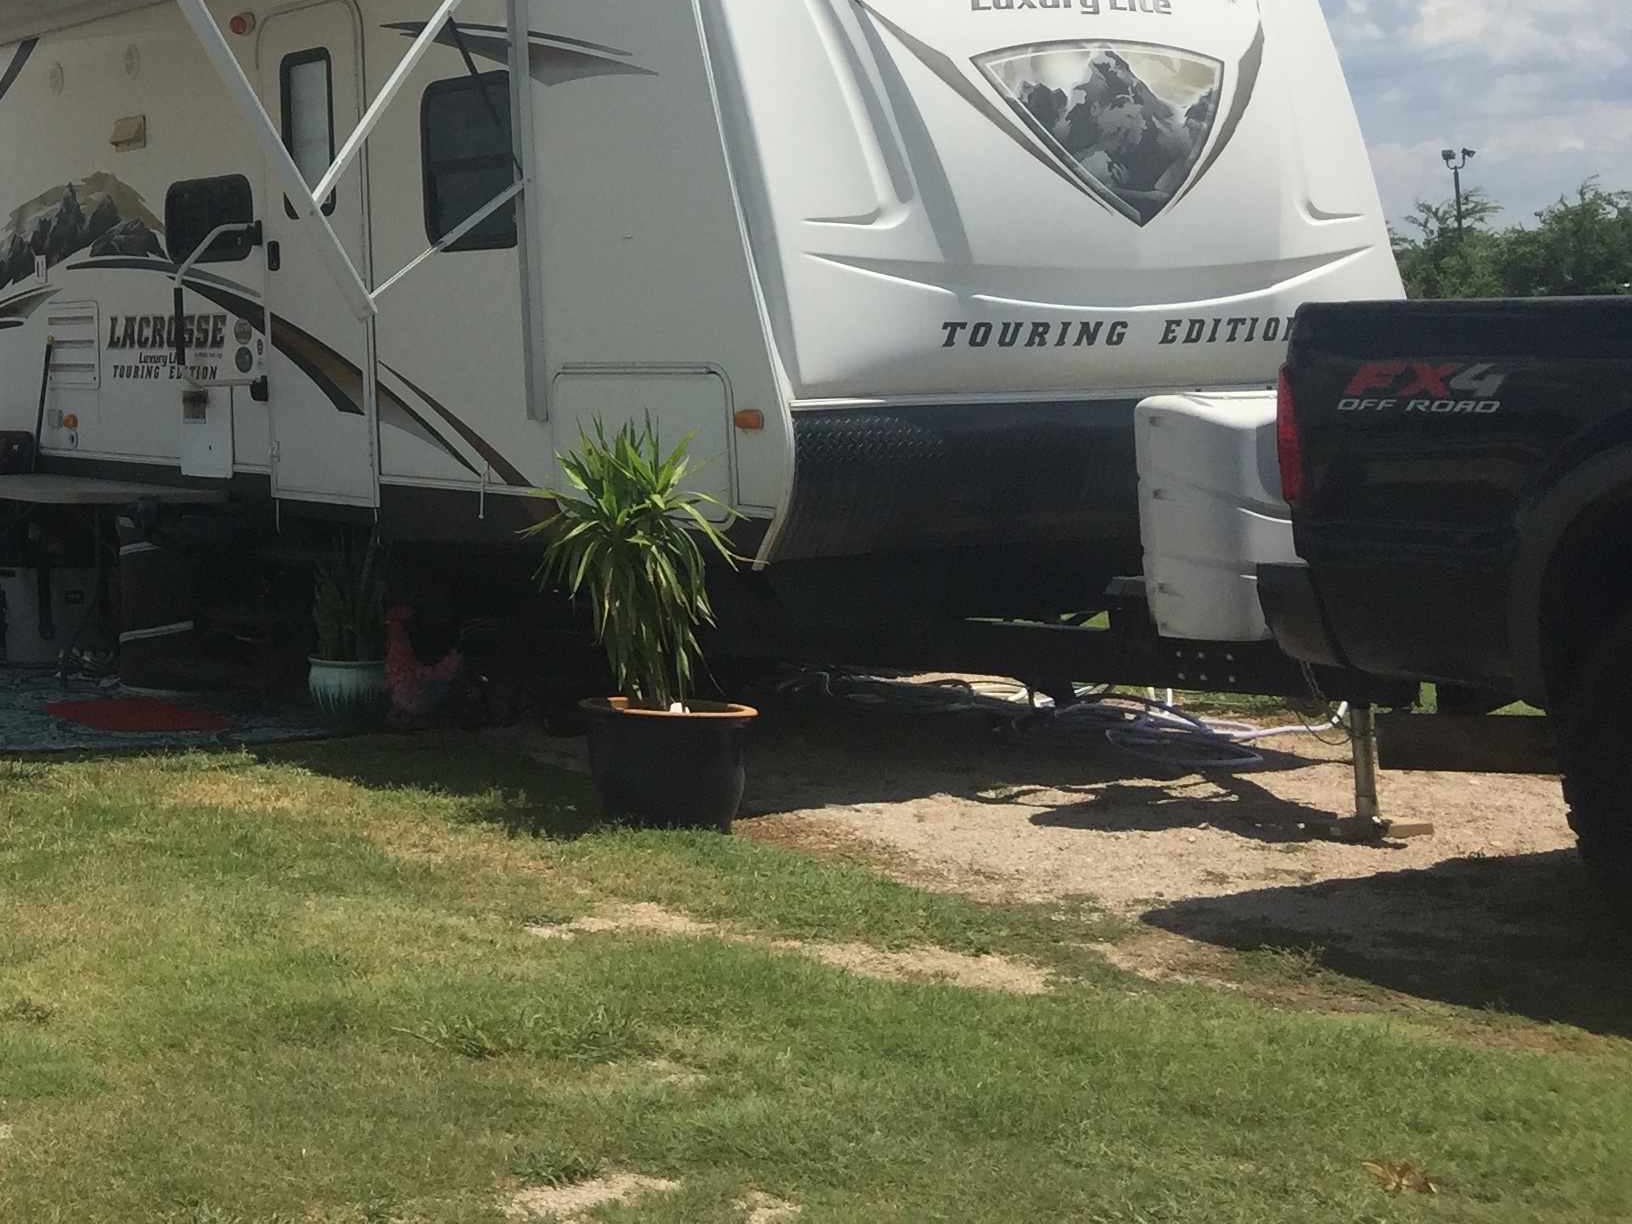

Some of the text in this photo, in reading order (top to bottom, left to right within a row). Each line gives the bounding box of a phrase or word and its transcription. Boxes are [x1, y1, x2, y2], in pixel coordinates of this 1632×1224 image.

[107, 314, 227, 348] LACROSSE
[942, 319, 1129, 348] TOURING
[139, 352, 168, 367] Luxury
[113, 365, 160, 380] TOURING
[1345, 362, 1506, 397] FX4
[1337, 398, 1501, 414] OFF ROAD
